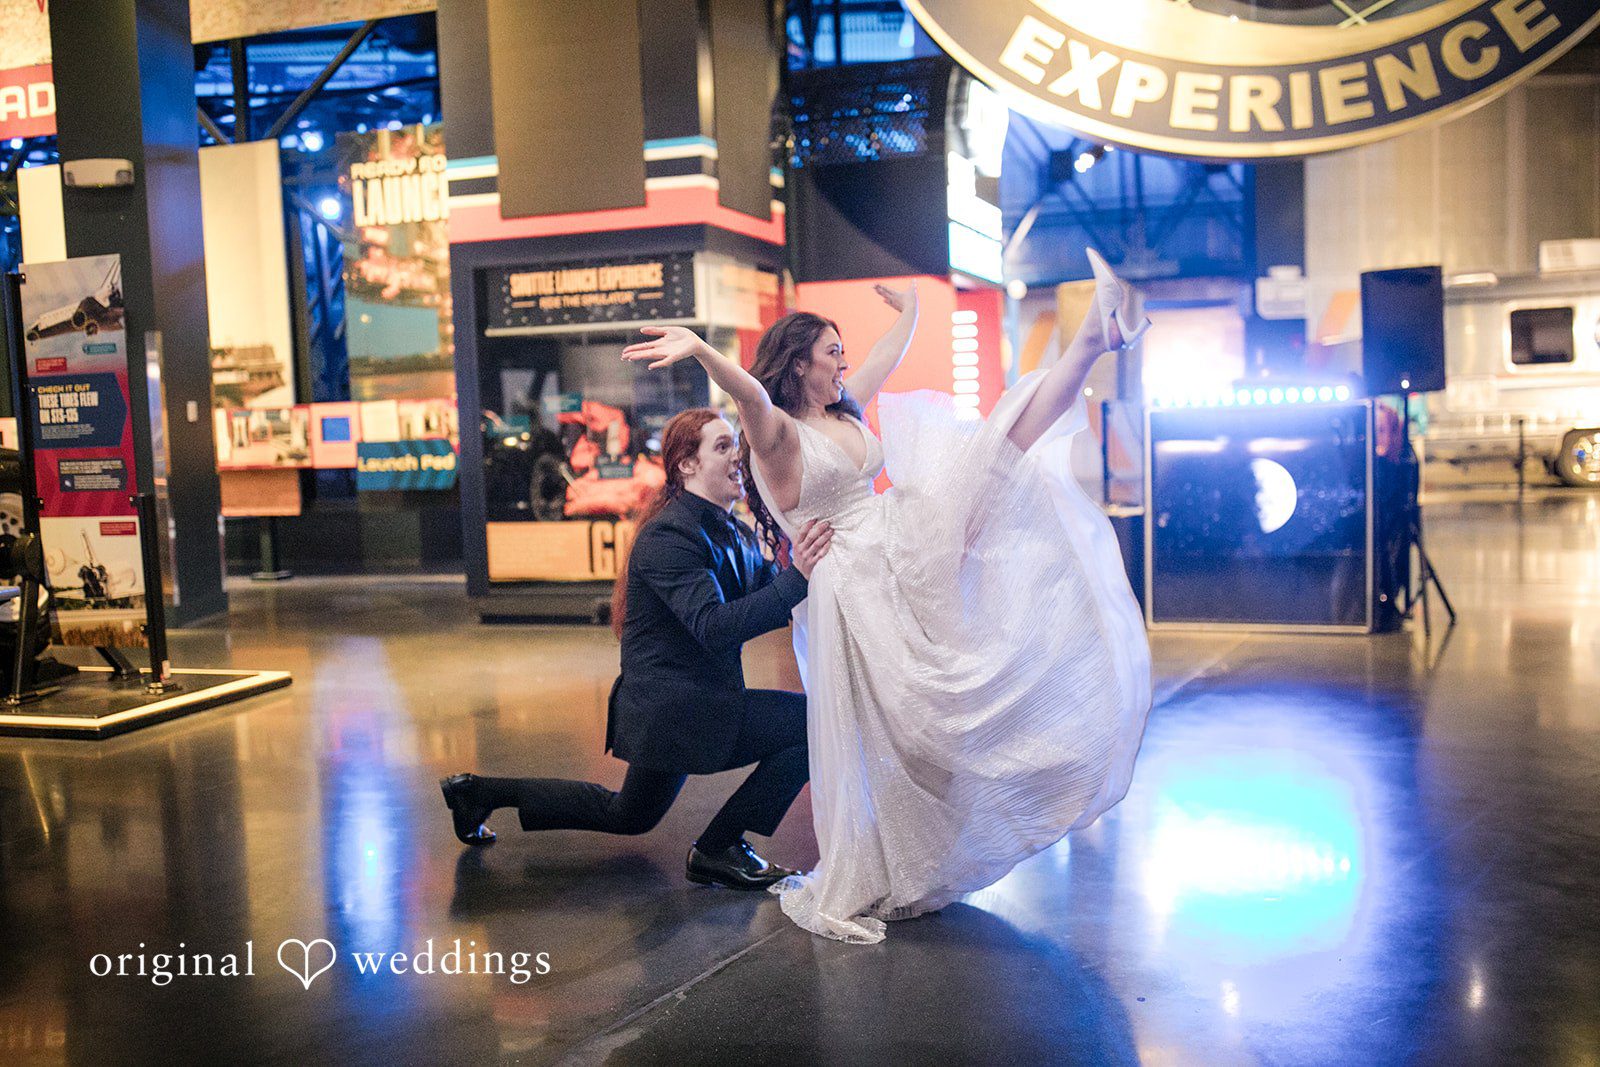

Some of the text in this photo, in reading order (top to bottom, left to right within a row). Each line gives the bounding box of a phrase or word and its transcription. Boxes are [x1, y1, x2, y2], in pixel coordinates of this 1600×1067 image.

[998, 0, 1562, 133] EXPERIENCE
[350, 156, 417, 179] READY
[510, 263, 664, 298] SHUTTLE LAUNCH EXPERIENCE
[38, 383, 90, 394] CHECK IT OUT
[38, 393, 59, 409] THESE
[80, 391, 98, 407] FLEW
[358, 452, 456, 472] Launch Pad
